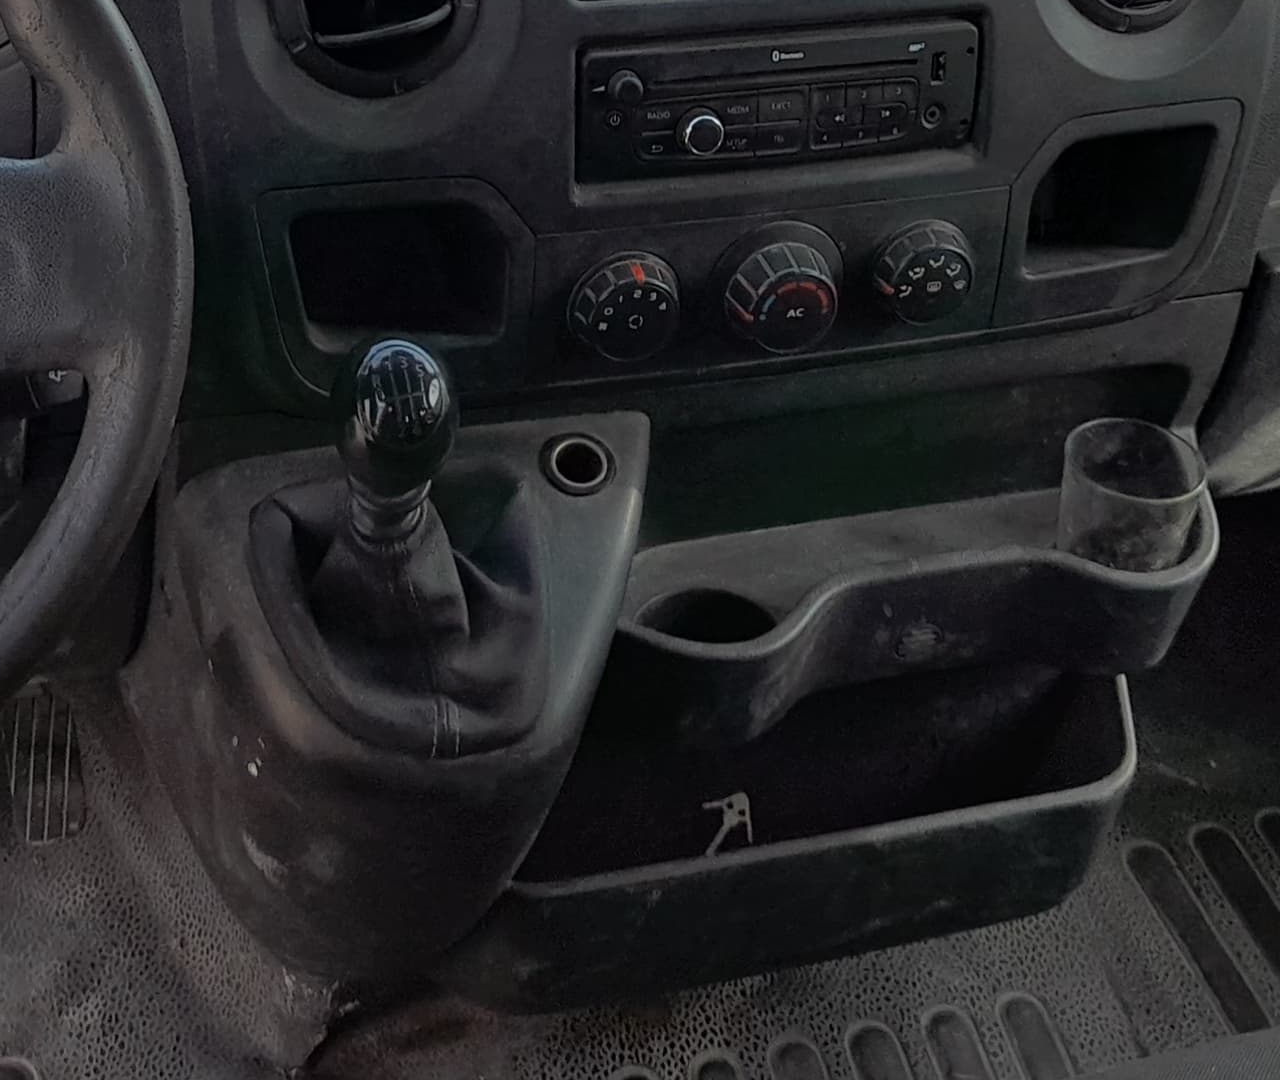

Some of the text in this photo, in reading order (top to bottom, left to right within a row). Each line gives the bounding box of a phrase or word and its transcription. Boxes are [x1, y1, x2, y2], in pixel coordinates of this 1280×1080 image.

[646, 111, 671, 121] RADIO
[632, 289, 643, 299] 2
[649, 291, 658, 302] 3
[658, 301, 668, 311] 4
[786, 307, 806, 319] AC
[399, 356, 409, 369] 3
[415, 362, 425, 377] 5
